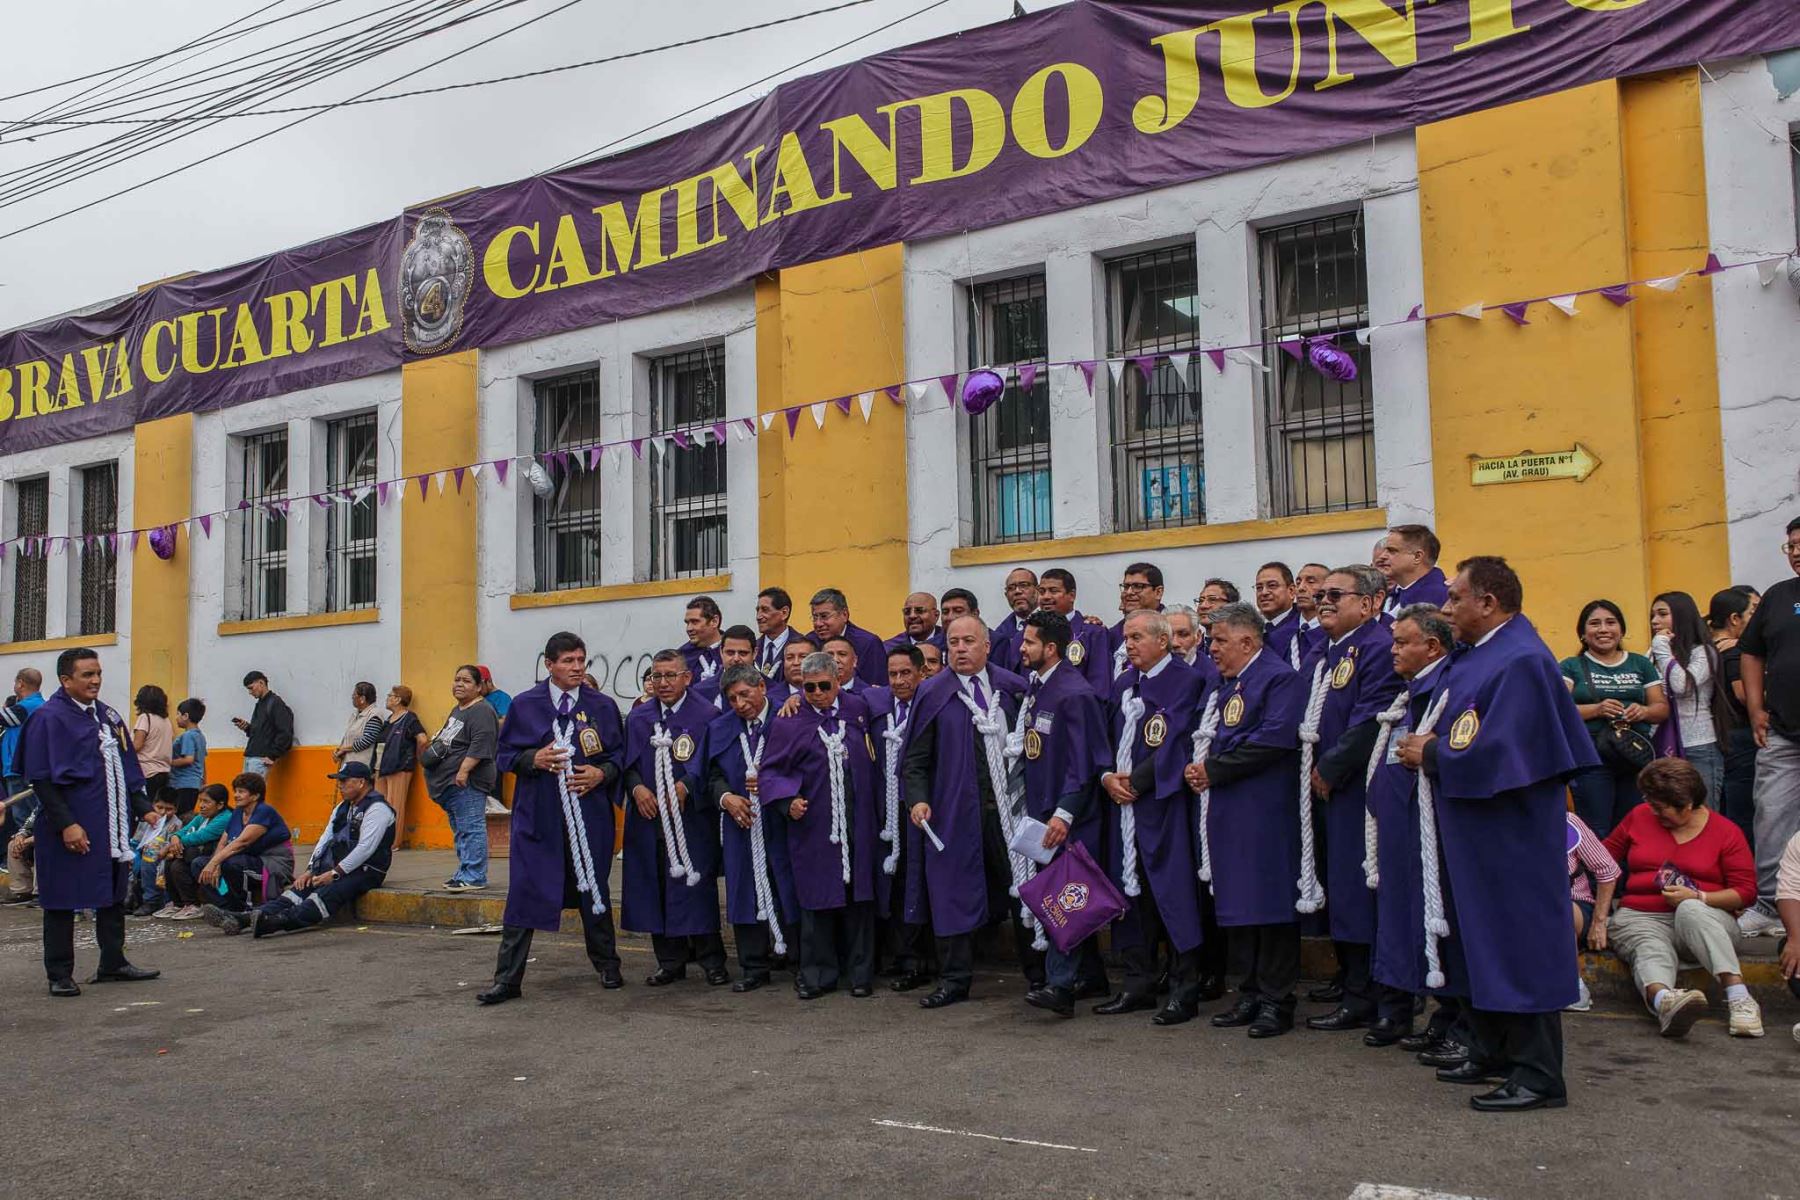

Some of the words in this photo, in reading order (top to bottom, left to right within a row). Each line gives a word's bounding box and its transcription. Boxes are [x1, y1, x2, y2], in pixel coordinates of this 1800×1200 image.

[142, 267, 391, 383] CUARTA
[483, 62, 1104, 299] CAMINANDO
[1132, 0, 1646, 134] JUN
[1478, 461, 1505, 471] HACIA
[1507, 459, 1519, 468] LA
[1521, 456, 1556, 467] PUERTA
[1521, 467, 1549, 477] GRAU)
